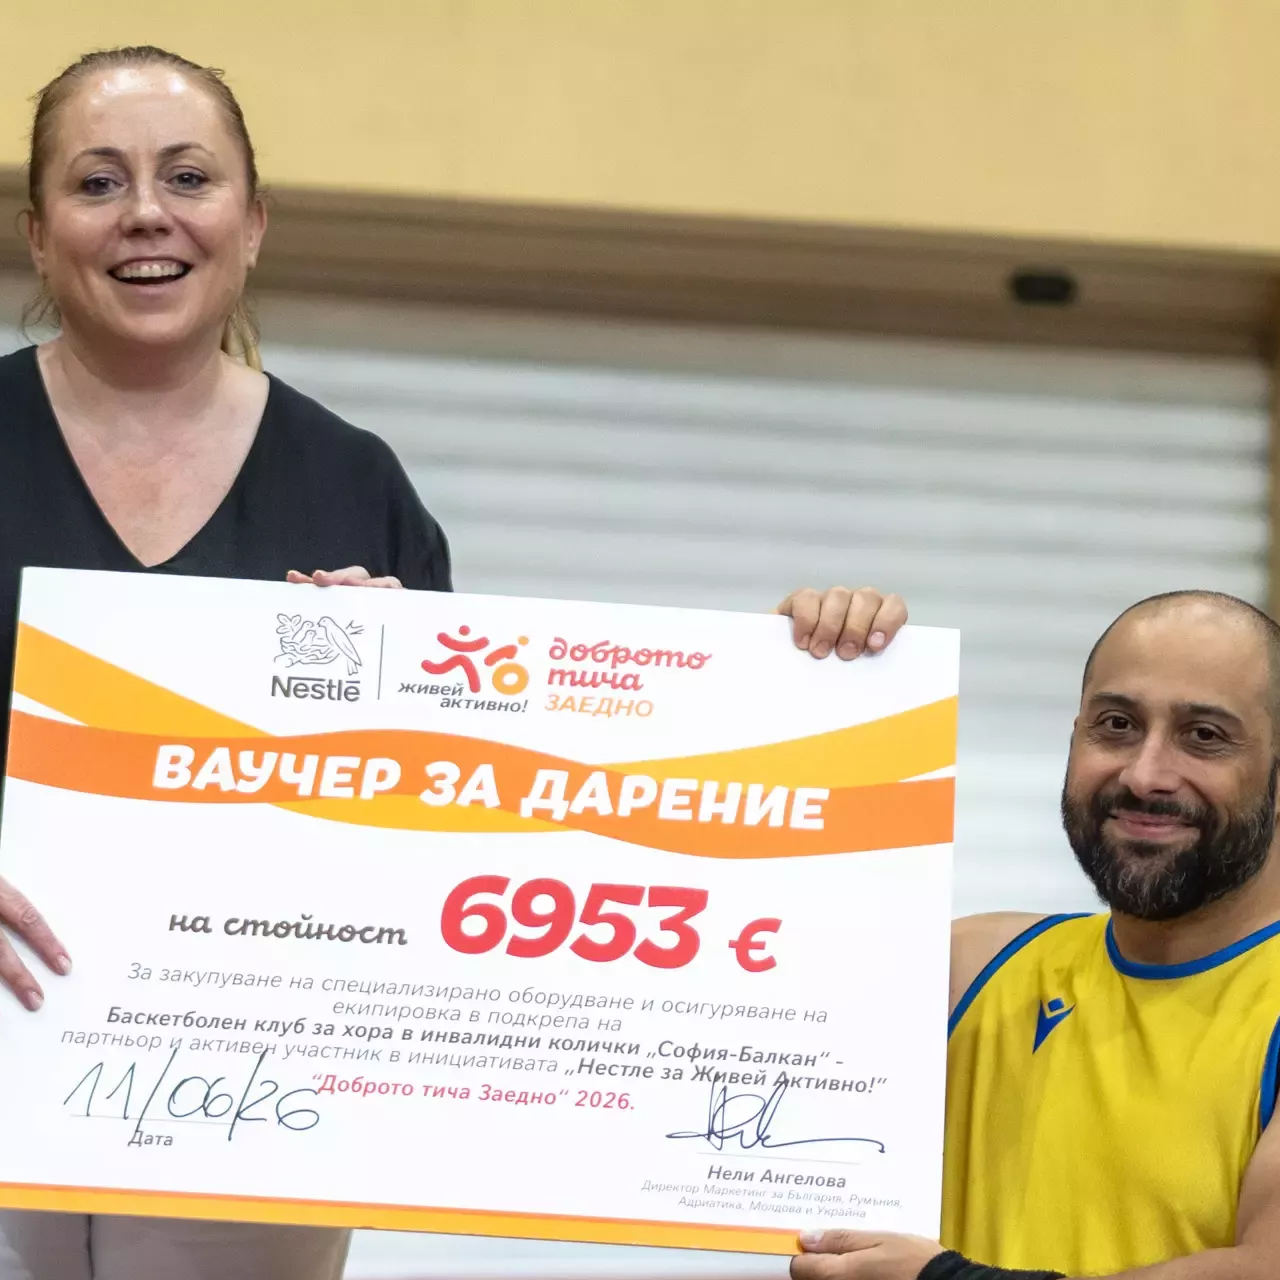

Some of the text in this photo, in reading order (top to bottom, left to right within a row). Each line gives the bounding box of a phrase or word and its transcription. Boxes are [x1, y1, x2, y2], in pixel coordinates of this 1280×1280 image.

[549, 637, 712, 669] доброто
[398, 682, 465, 697] живей
[547, 667, 644, 691] тича
[440, 696, 529, 713] активно!
[544, 694, 654, 718] ЗАЕДНО
[152, 744, 829, 830] ВАУЧЕР ЗА ДАРЕНИЕ
[167, 874, 783, 972] на стойност 6953 €
[127, 961, 828, 1024] За закупуване на специализирано оборудване и осигуряване на
[106, 1005, 248, 1031] Баскетболен
[253, 1016, 308, 1039] клуб
[311, 1022, 336, 1037] за
[340, 1024, 394, 1044] хора
[400, 1027, 415, 1041] в
[419, 1029, 542, 1050] инвалидни
[547, 1037, 641, 1056] колички
[332, 1001, 623, 1032] екипировка в подкрепа на
[60, 1030, 163, 1053] партньор
[170, 1037, 183, 1051] и
[189, 1038, 277, 1054] активен
[281, 1043, 384, 1062] участник
[388, 1050, 401, 1063] в
[407, 1051, 559, 1073] инициативата
[659, 1067, 684, 1081] за
[690, 1065, 767, 1085] Живей
[421, 1084, 472, 1101] тича
[574, 1089, 636, 1111] 2026.
[128, 1130, 174, 1147] Дата
[707, 1164, 847, 1189] Нели Ангелова
